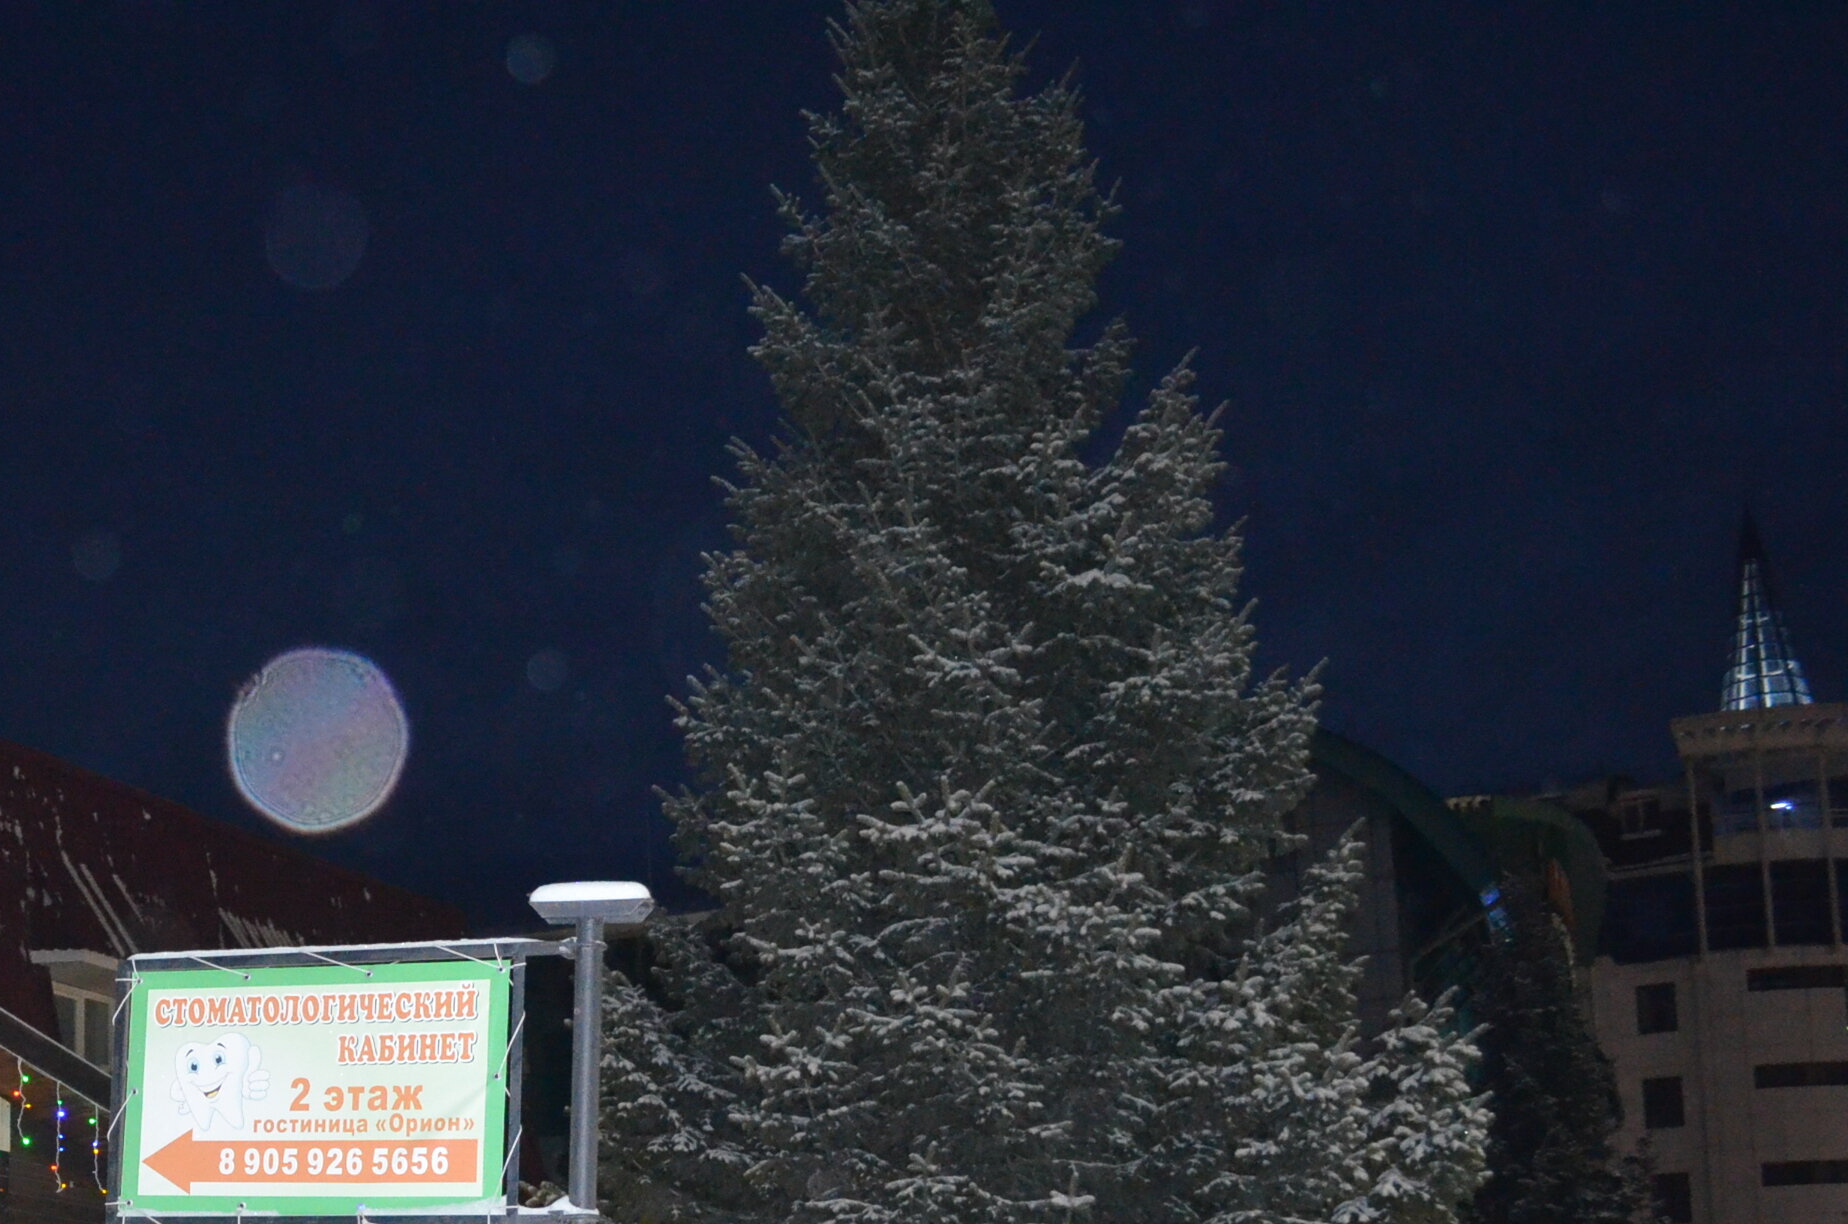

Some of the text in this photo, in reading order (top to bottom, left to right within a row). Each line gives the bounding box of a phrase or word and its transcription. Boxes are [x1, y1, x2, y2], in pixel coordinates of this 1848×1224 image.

[154, 984, 479, 1028] СТОМАТОЛОГИЧЕСКИЙ
[337, 1031, 476, 1065] КАБИНЕТ
[290, 1078, 423, 1112] 2 этаж
[253, 1112, 475, 1138] гостиница «Орион»
[218, 1146, 449, 1176] 8 905 926 5656
